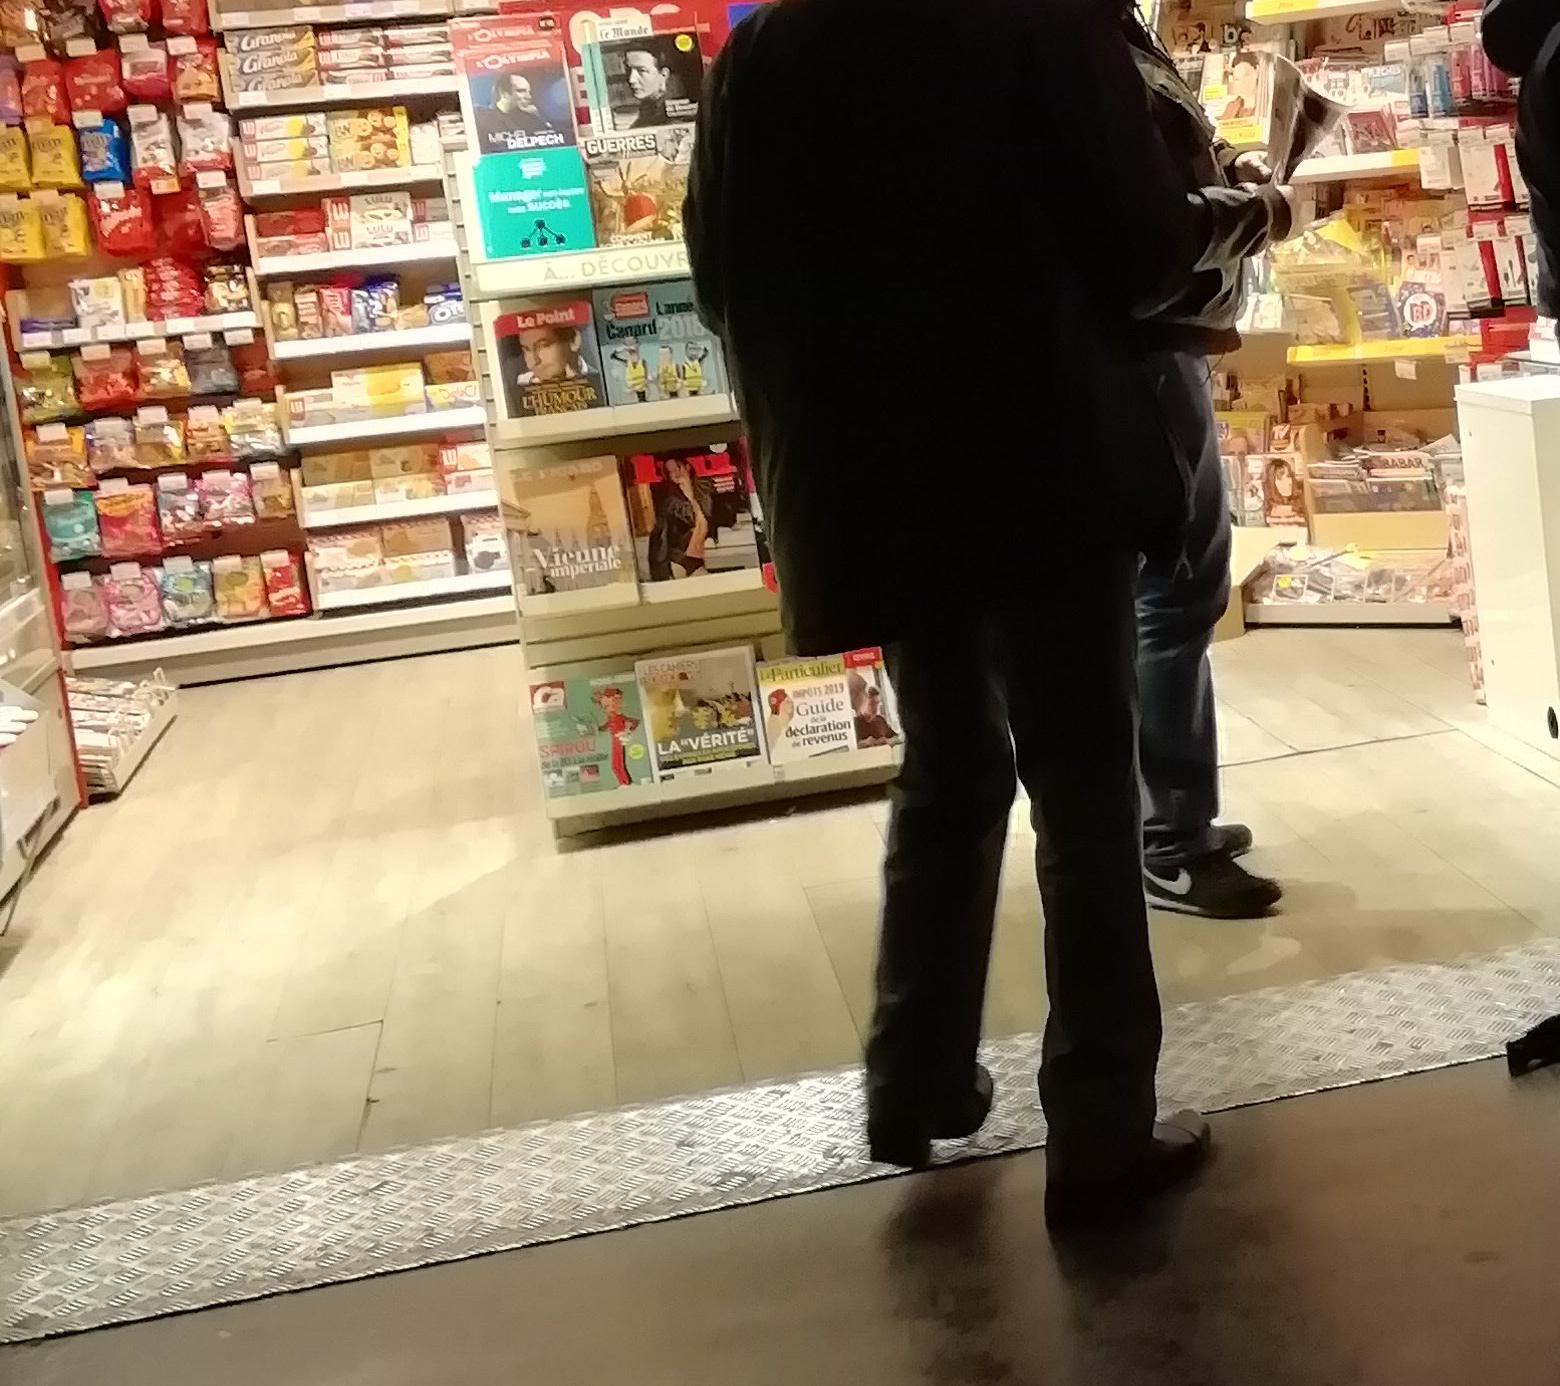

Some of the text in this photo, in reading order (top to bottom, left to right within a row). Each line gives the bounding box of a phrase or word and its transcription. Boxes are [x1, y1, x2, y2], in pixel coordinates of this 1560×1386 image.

[240, 29, 297, 51] Granola
[613, 25, 648, 39] Monde
[242, 51, 299, 73] Granola
[507, 133, 565, 149] DELPECH
[587, 134, 656, 155] GUERRES
[581, 249, 688, 278] DÉCOUVR
[516, 307, 576, 329] Le Point
[533, 543, 621, 569] Vienne
[771, 662, 843, 682] Particulier
[824, 682, 845, 696] 2019
[796, 698, 845, 717] Guide
[785, 719, 852, 738] déclaration
[657, 740, 682, 756] LA
[802, 731, 849, 747] revenus
